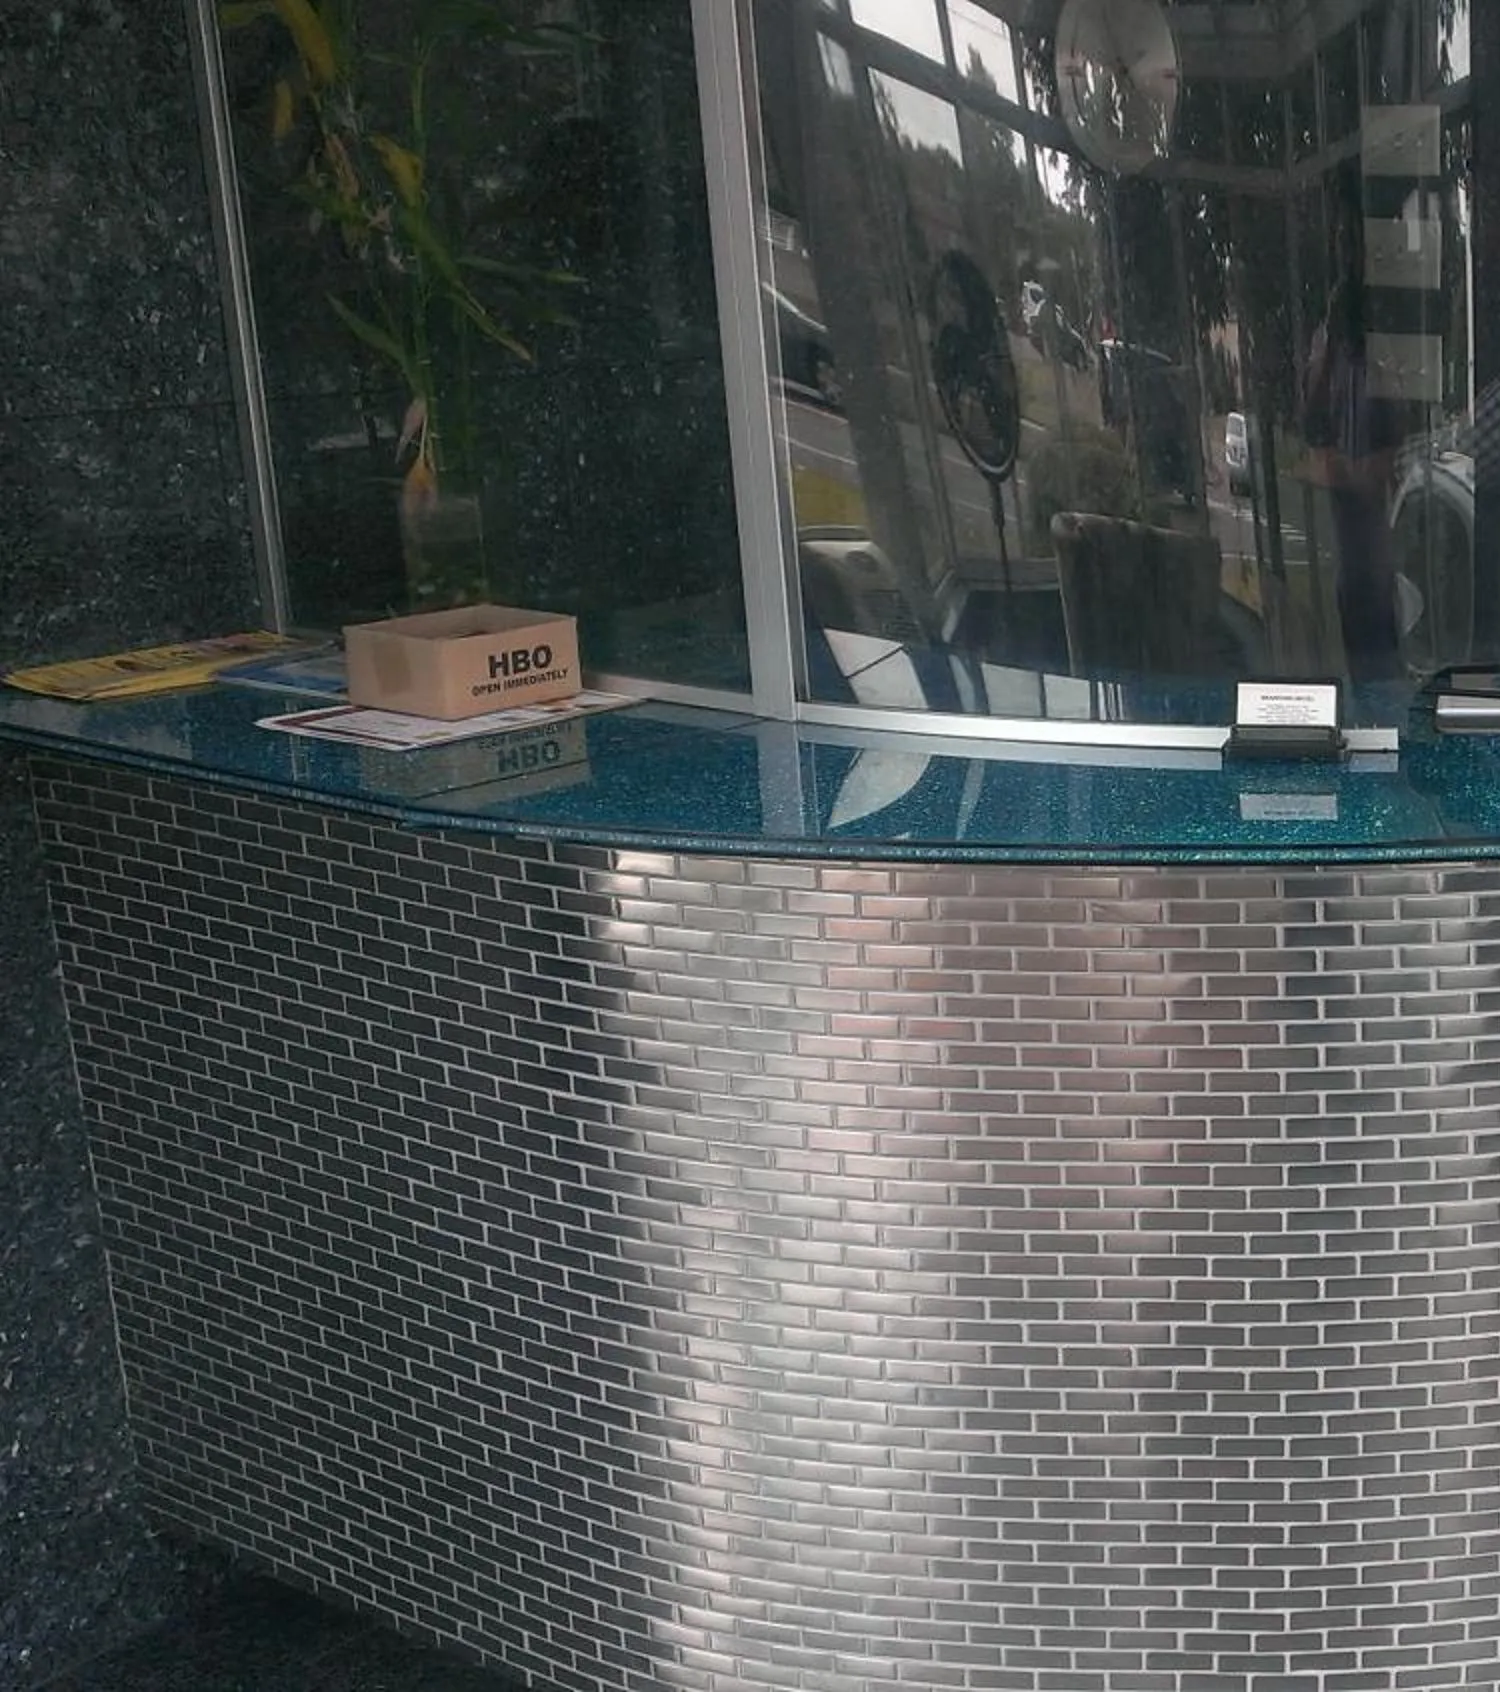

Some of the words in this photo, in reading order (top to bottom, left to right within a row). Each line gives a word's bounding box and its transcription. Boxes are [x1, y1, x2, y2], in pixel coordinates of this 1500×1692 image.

[488, 644, 552, 678] HBO
[471, 683, 500, 696] OPEN
[503, 669, 568, 691] IMMEDIATELY
